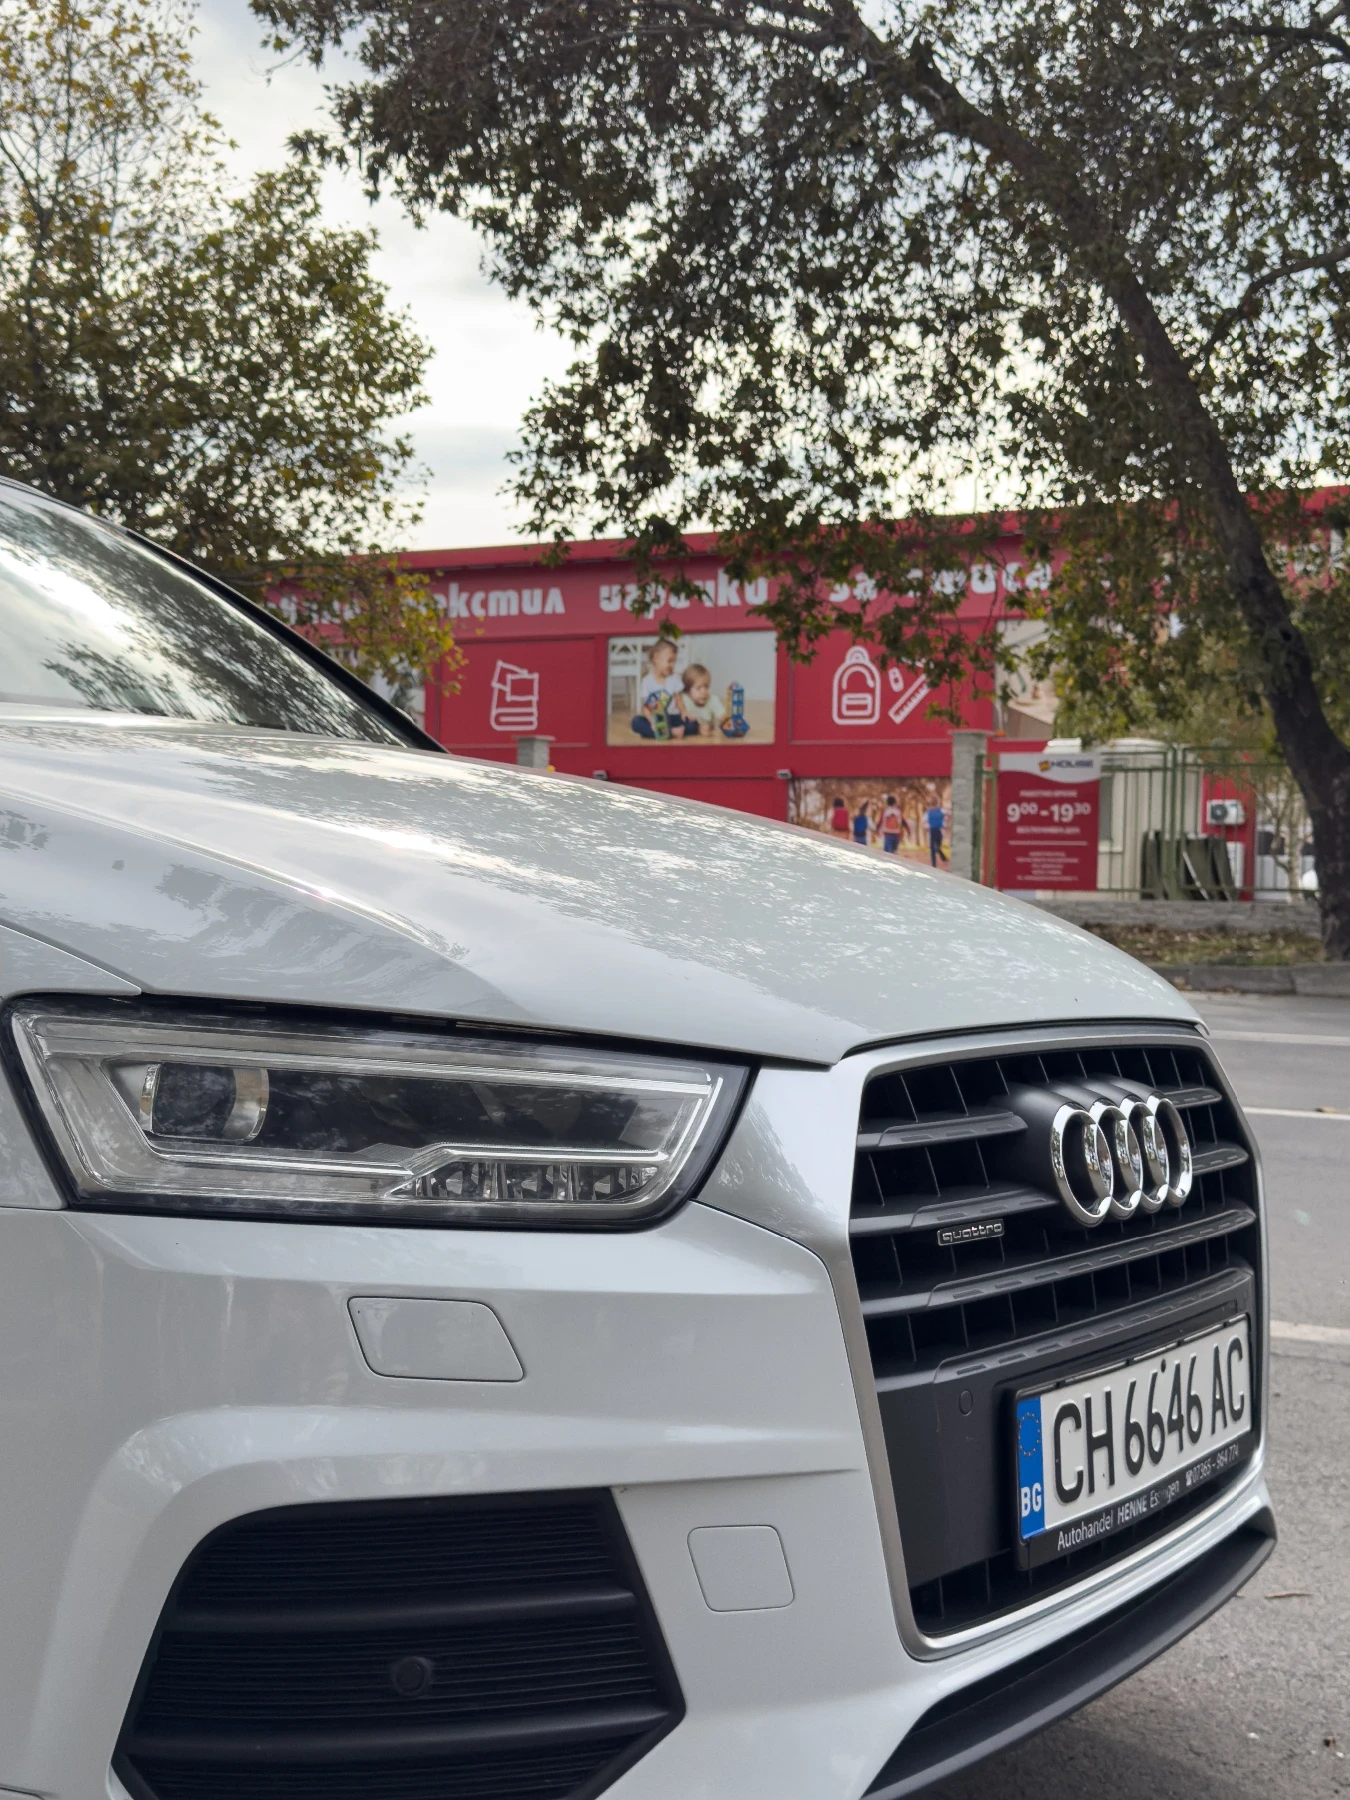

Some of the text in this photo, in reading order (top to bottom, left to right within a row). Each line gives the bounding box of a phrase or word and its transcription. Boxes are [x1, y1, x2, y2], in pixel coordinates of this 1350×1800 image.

[402, 582, 566, 619] екстил
[942, 1223, 1003, 1242] quattro
[1124, 1353, 1203, 1476] 6646
[1210, 1336, 1245, 1436] AC
[1020, 1482, 1043, 1518] BG
[1057, 1510, 1114, 1551] Autohandel
[1117, 1494, 1148, 1525] HENNE
[1150, 1480, 1180, 1508] Esgen
